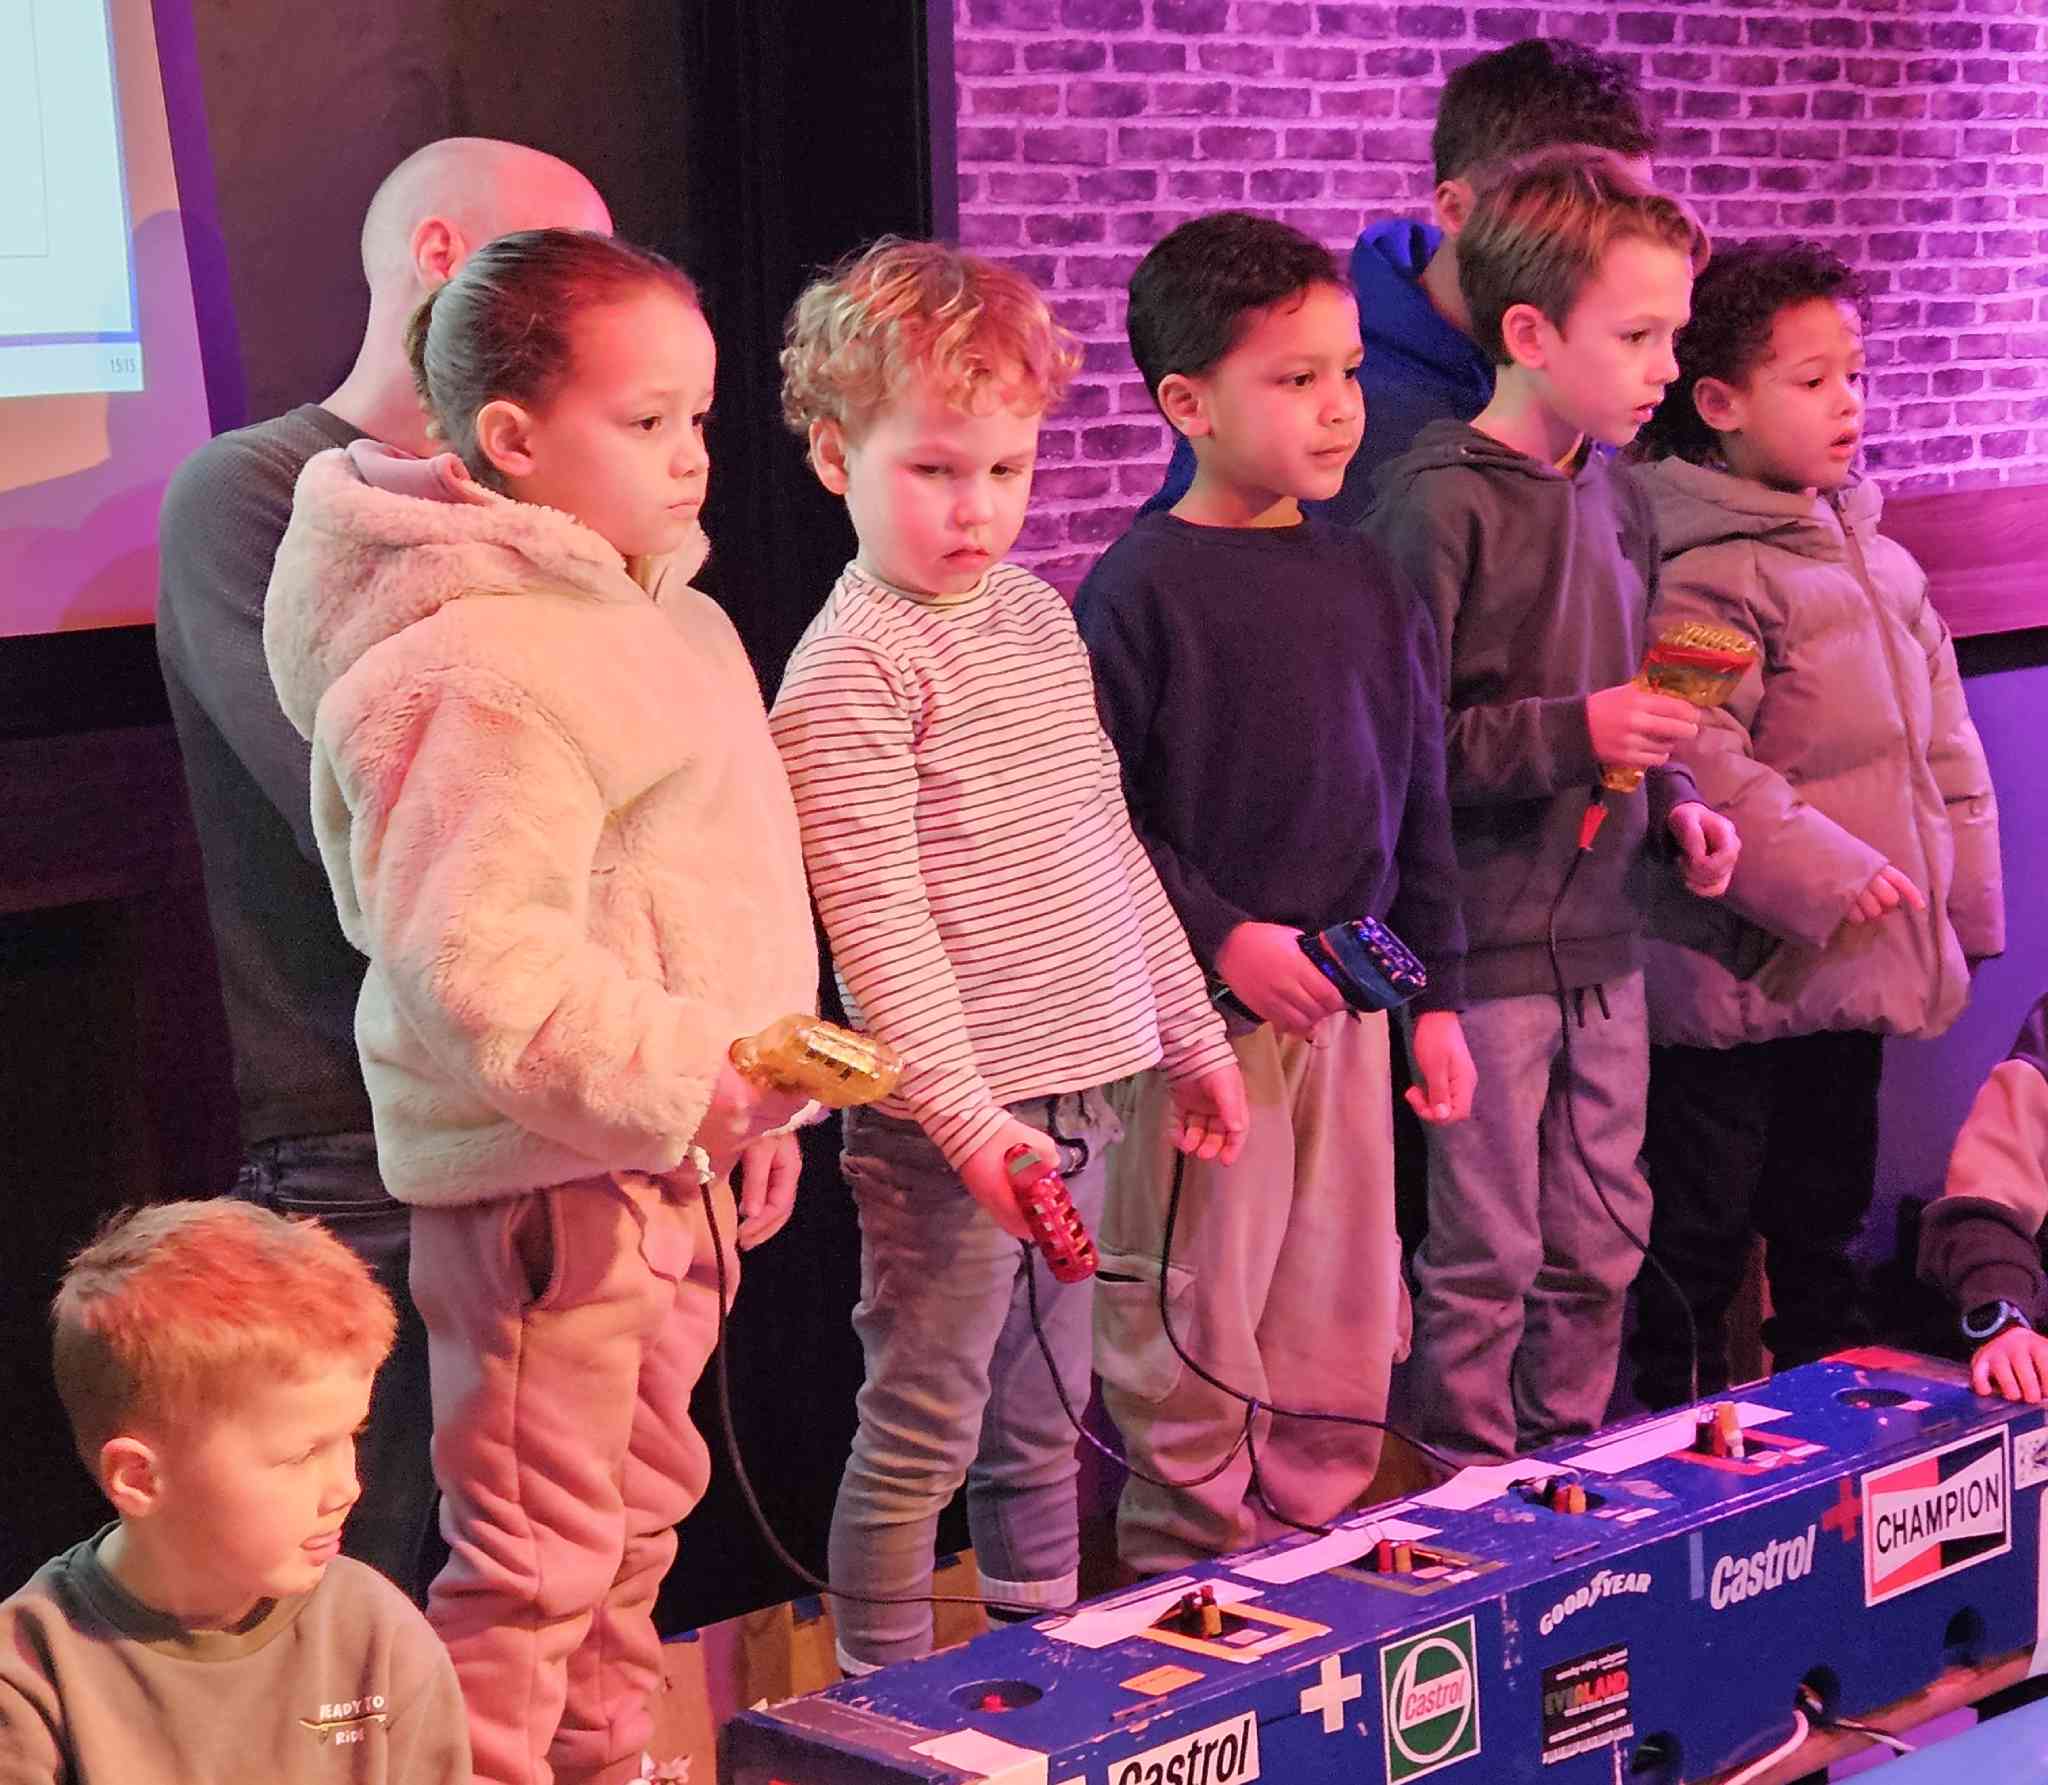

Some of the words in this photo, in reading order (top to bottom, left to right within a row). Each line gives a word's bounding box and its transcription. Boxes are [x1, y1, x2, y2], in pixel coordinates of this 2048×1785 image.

[1876, 1473, 2000, 1555] CHAMPION
[1539, 1568, 1652, 1636] GOODYEAR
[1709, 1523, 1817, 1611] Castrol
[1404, 1675, 1466, 1721] Castrol
